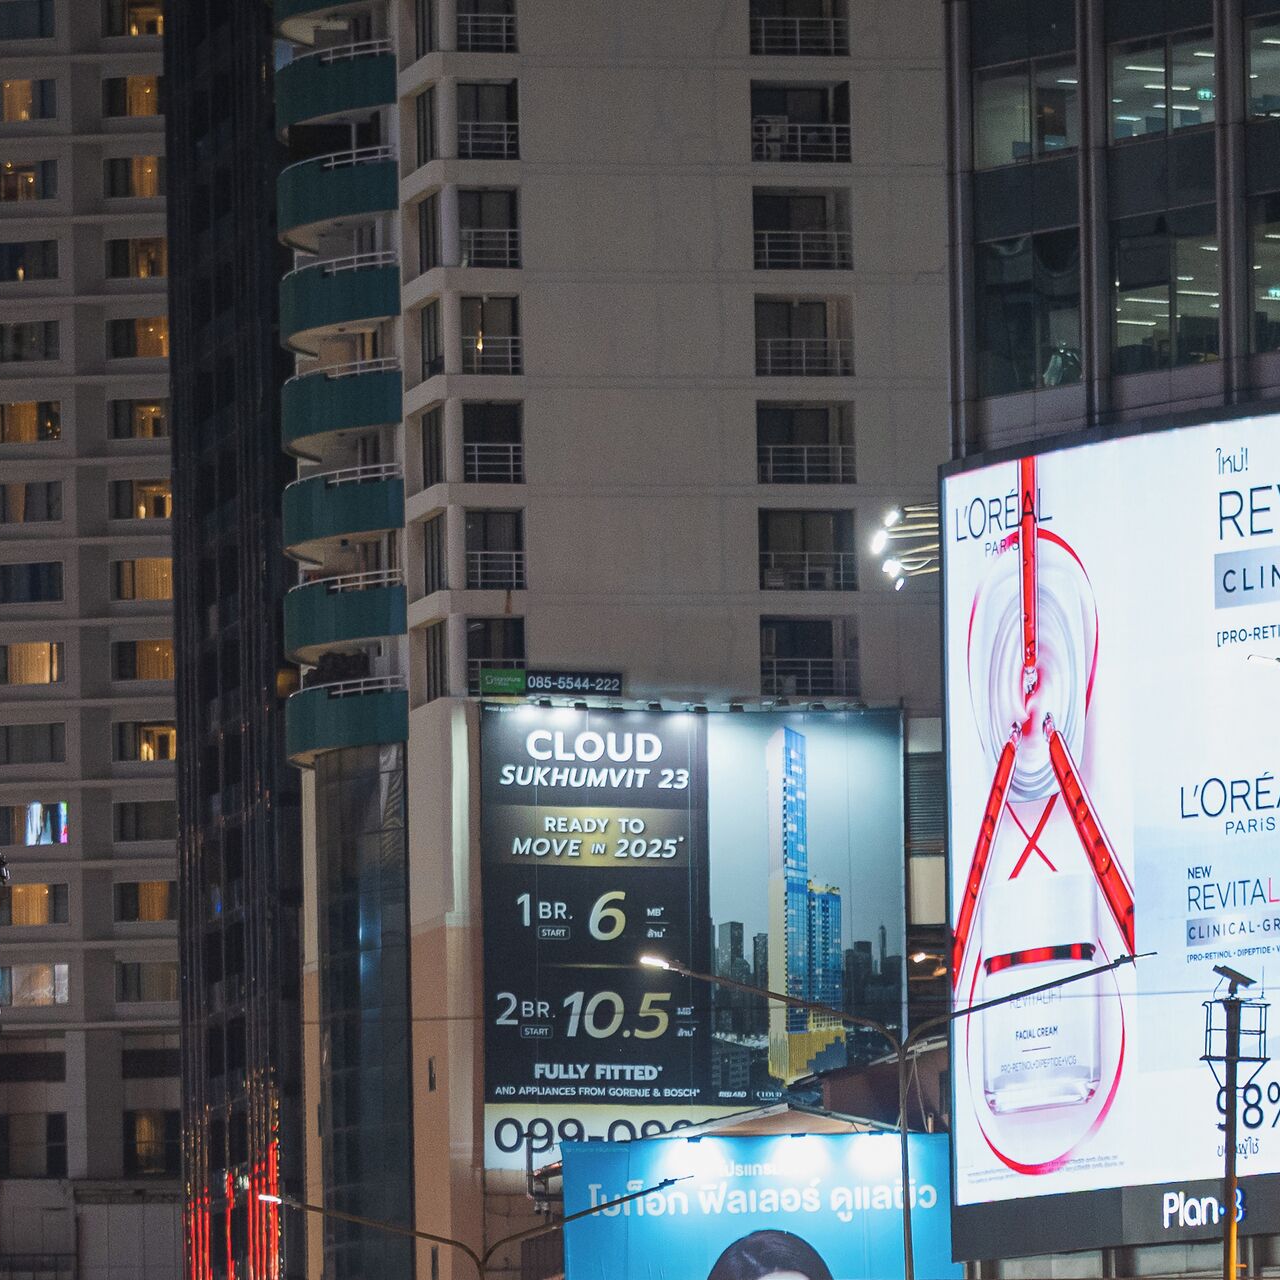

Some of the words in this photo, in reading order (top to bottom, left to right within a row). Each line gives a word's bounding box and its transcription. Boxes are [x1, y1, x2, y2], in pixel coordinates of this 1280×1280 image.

[1215, 447, 1249, 475] ใหม่!
[527, 676, 620, 691] 085-5544-222
[526, 729, 663, 763] CLOUD
[500, 763, 651, 789] SUKHUMVIT
[657, 768, 690, 790] 23
[544, 816, 609, 833] READY
[617, 818, 646, 834] TO
[511, 837, 583, 857] MOVE
[590, 842, 606, 855] IN
[1187, 864, 1213, 881] NEW
[516, 893, 531, 927] 1
[538, 901, 574, 920] BR.
[588, 890, 627, 941] 6
[541, 928, 566, 938] START
[495, 992, 519, 1026] 2
[521, 1000, 556, 1019] BR.
[563, 990, 671, 1040] 10.5
[523, 1028, 549, 1037] START
[1015, 1030, 1036, 1042] FACIAL
[1036, 1024, 1059, 1039] CREAM
[534, 1063, 590, 1080] FULLY
[495, 1086, 516, 1096] AND
[519, 1086, 577, 1097] APPLIANCES
[579, 1087, 606, 1097] FROM
[608, 1087, 650, 1098] GORENJE
[652, 1088, 661, 1098] &
